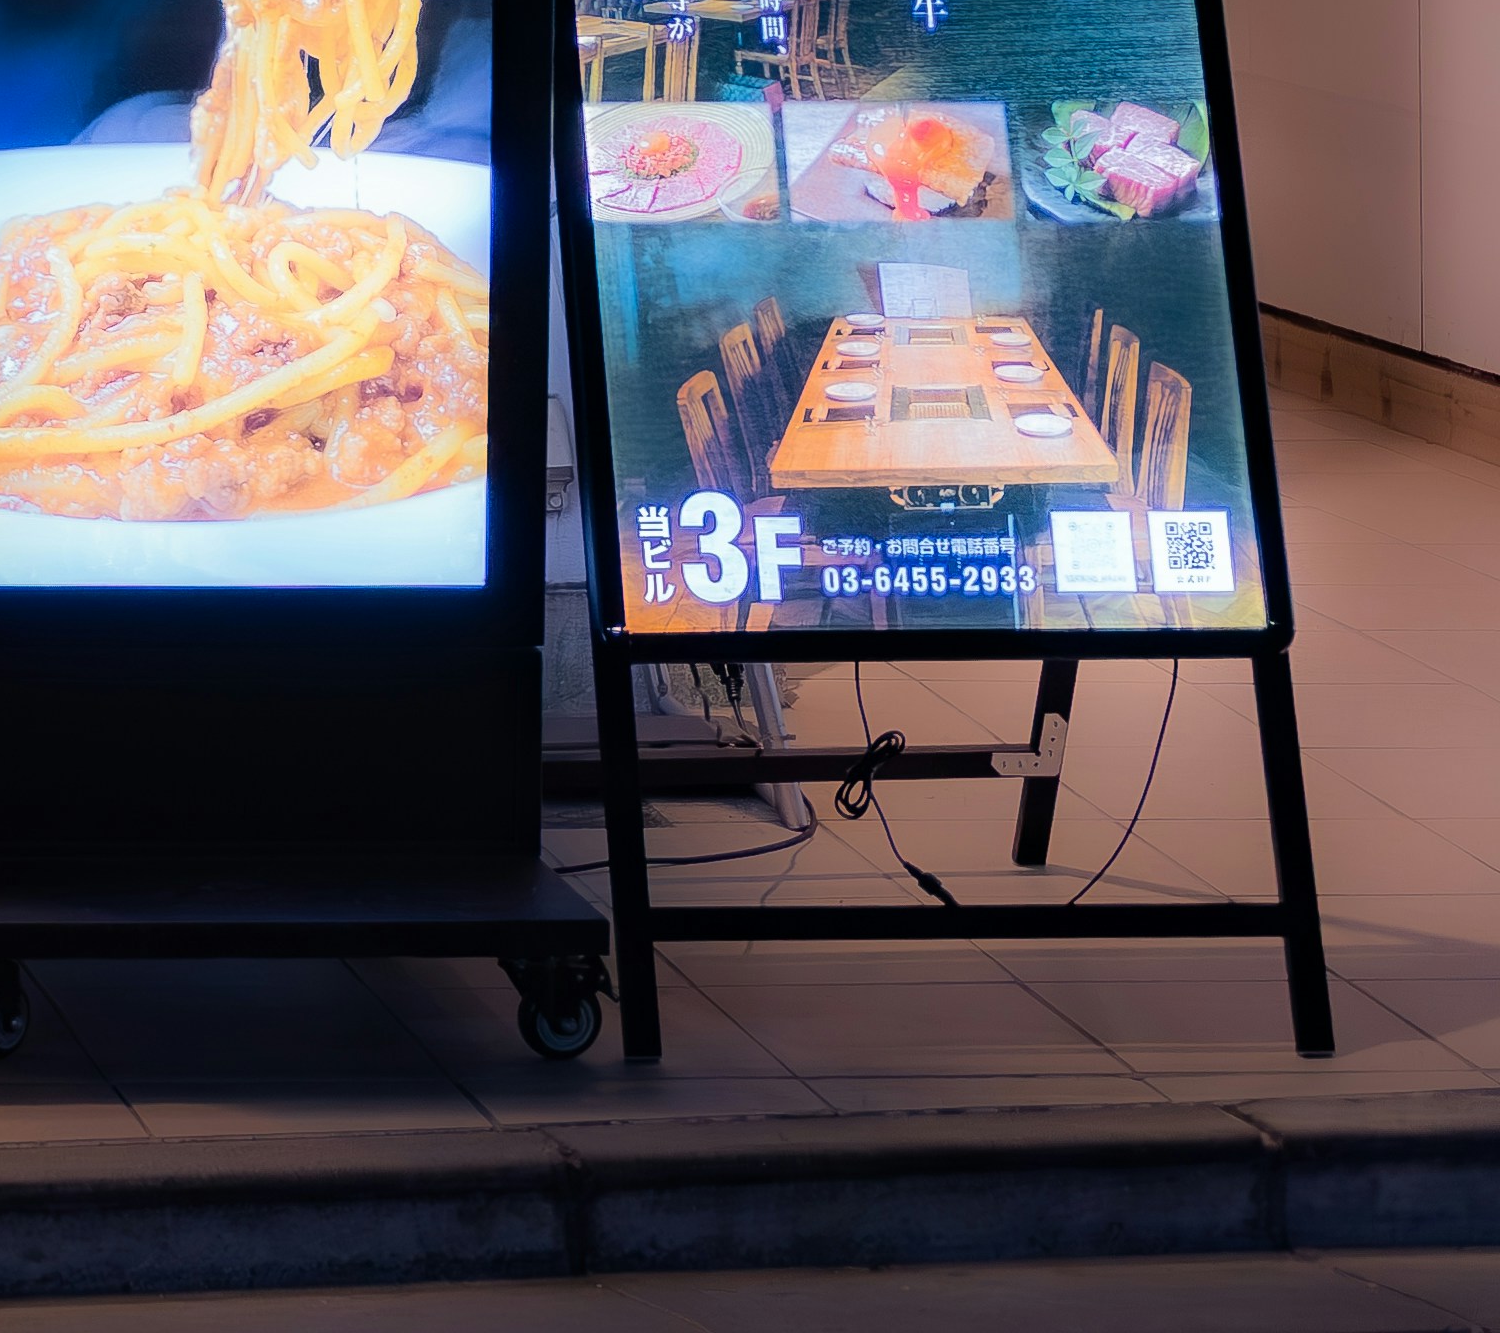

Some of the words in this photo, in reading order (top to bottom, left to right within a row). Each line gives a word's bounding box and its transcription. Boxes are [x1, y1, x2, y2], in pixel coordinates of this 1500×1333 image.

[636, 507, 676, 604] 当ビル
[678, 490, 804, 604] 3F
[821, 537, 1016, 558] ご予約・お問合せ電話番号
[822, 565, 1036, 595] 03-6455-2933
